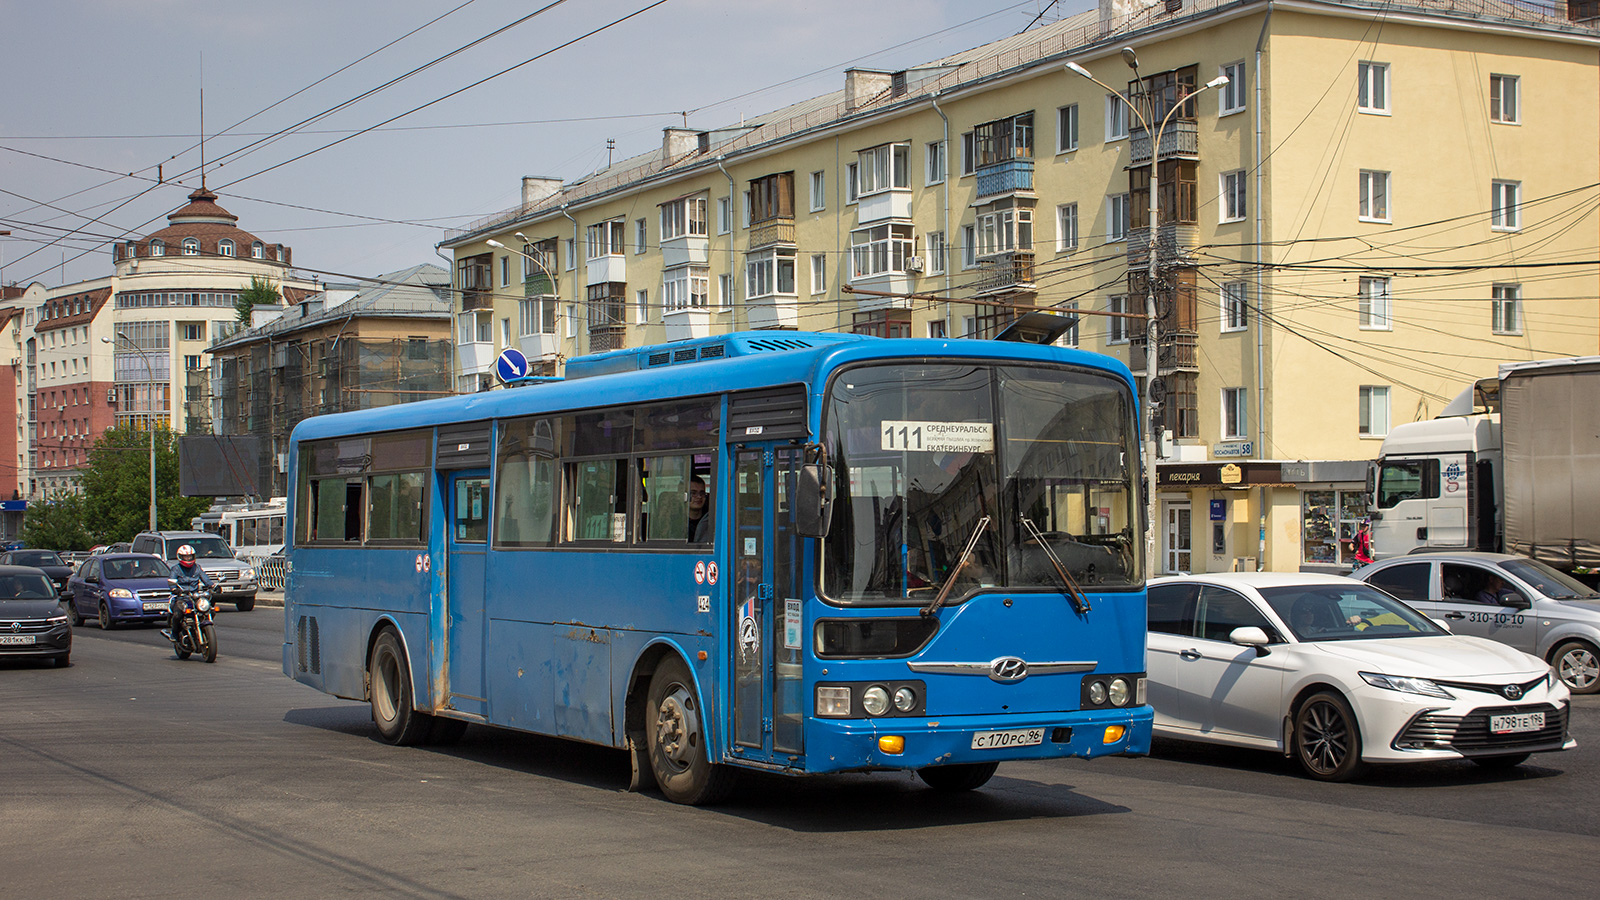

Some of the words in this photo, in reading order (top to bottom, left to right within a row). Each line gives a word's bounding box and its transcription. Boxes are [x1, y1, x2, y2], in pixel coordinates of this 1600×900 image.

[926, 424, 988, 434] СРЕДНЕУРАЛЬСК
[885, 425, 922, 449] 111
[926, 444, 981, 453] ЕКАТЕРИНБУРГ
[1242, 443, 1251, 455] 58
[1169, 472, 1201, 484] пекарня
[1469, 612, 1525, 625] 310-10-10
